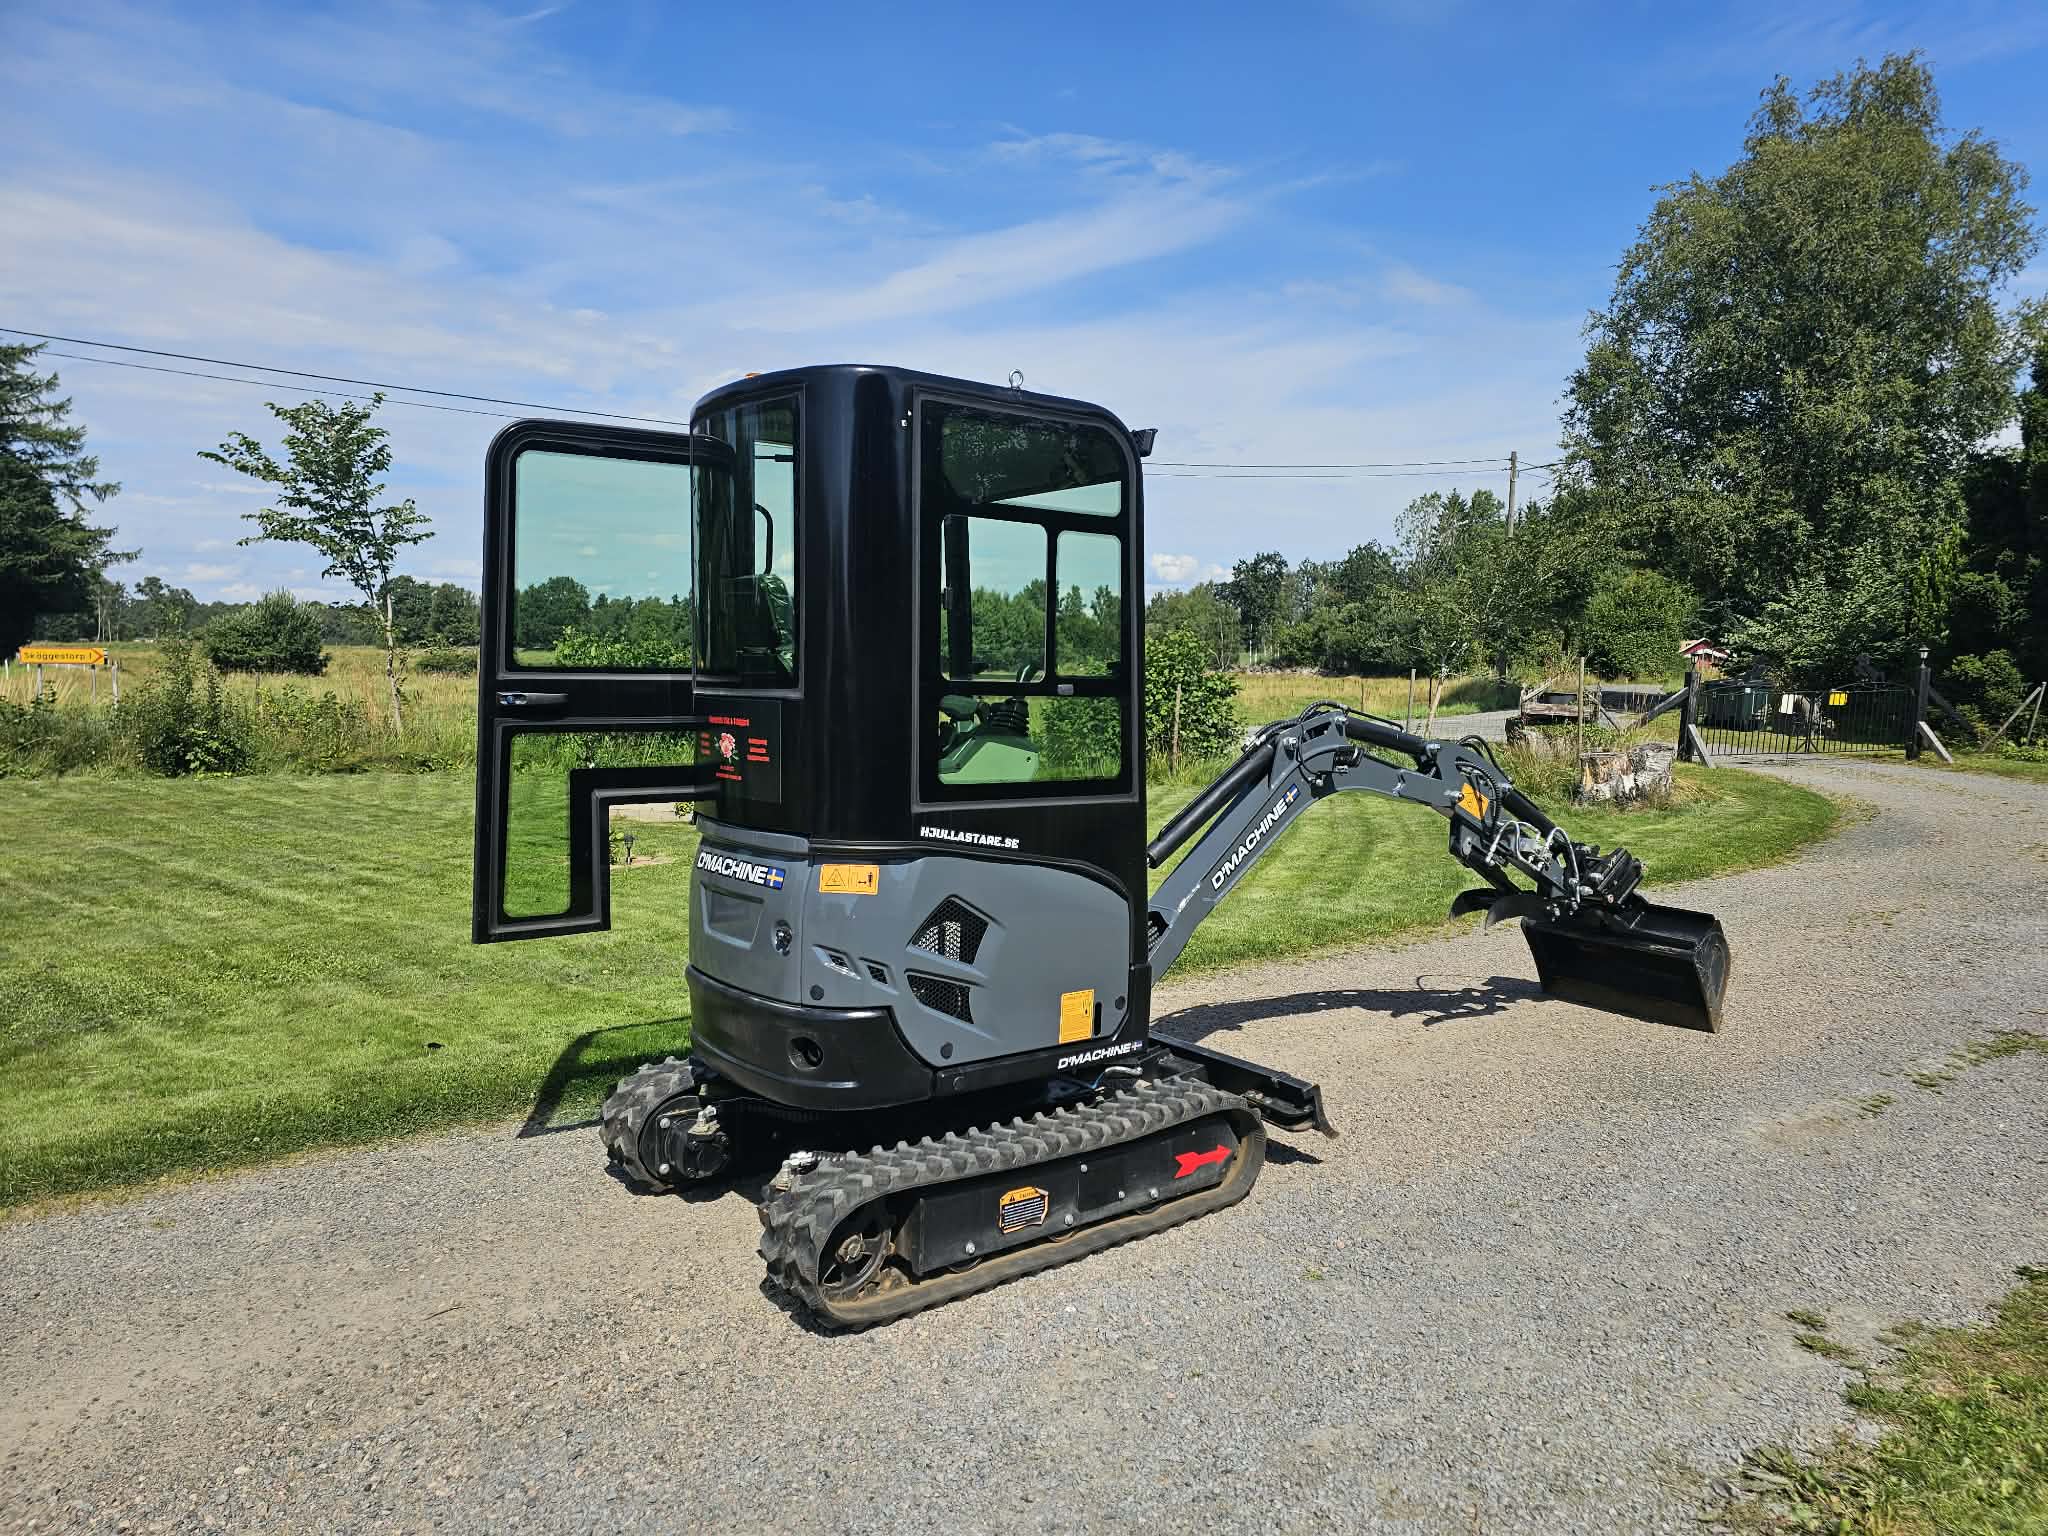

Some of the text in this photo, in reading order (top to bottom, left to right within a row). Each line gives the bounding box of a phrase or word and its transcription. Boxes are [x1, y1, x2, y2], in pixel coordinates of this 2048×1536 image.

[920, 826, 1019, 849] HJULLASTARE.SE
[1211, 798, 1288, 890] D'MACHINE
[697, 852, 768, 884] D'MACHINE
[1058, 1043, 1132, 1069] D'MACHINE
